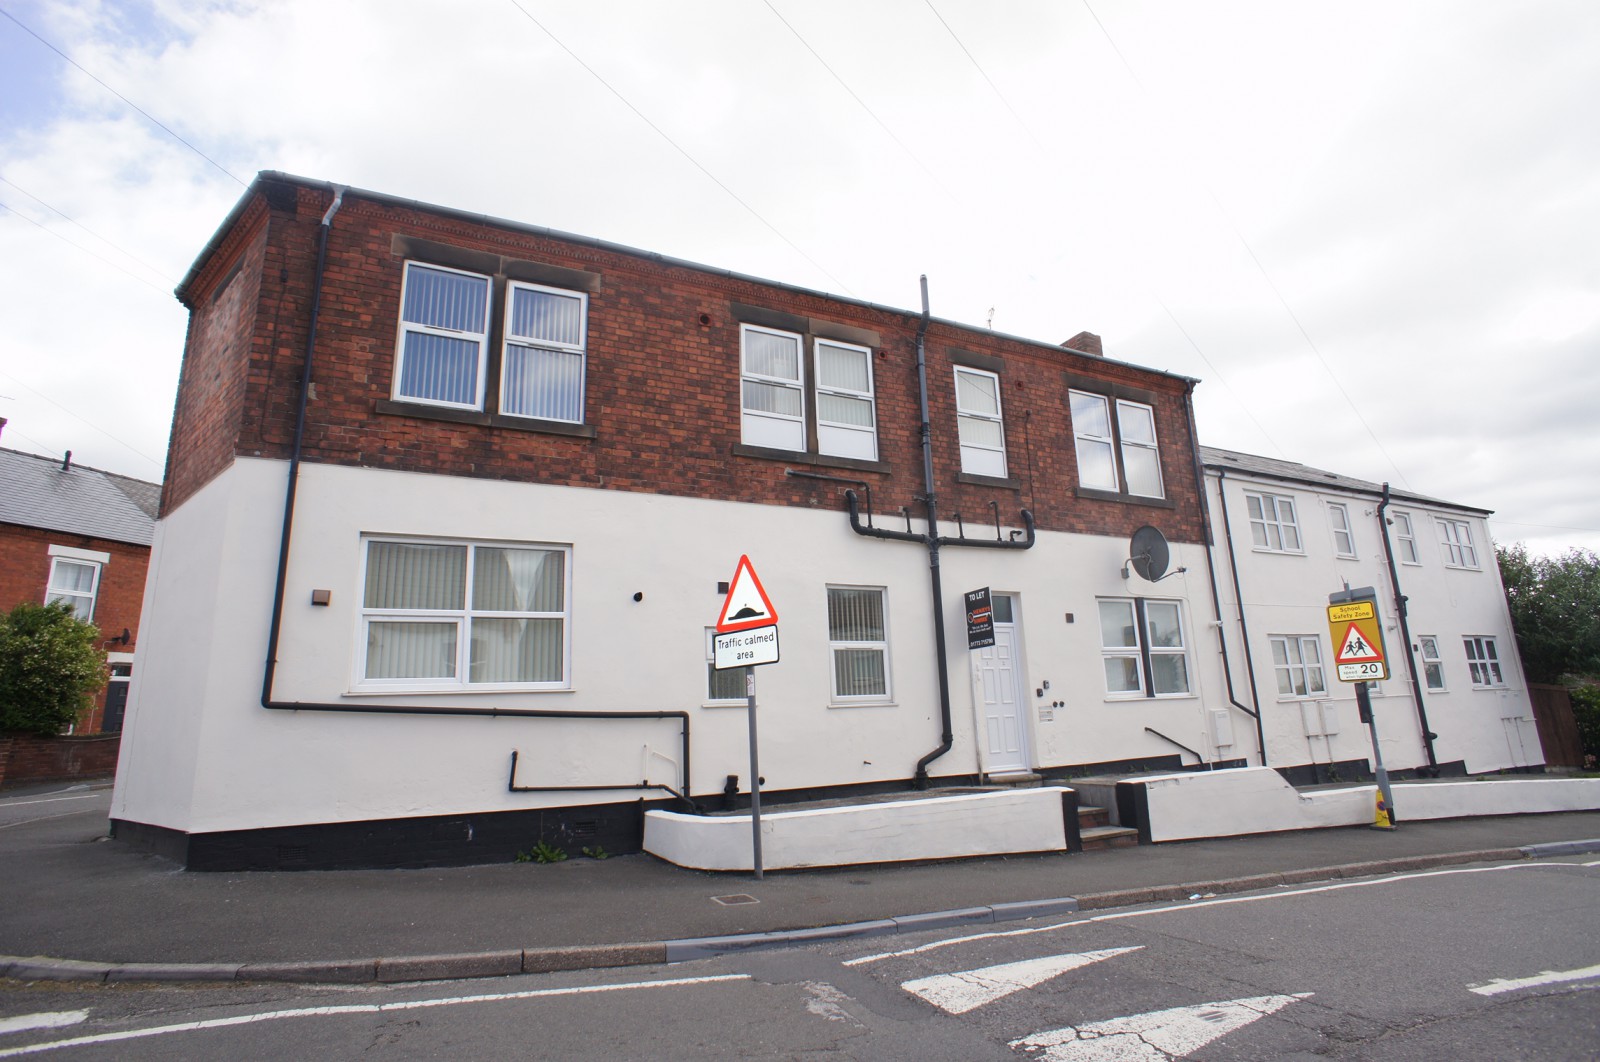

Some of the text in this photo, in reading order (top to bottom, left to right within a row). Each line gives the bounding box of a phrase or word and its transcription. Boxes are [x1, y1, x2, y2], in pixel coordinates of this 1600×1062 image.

[976, 591, 985, 600] LET
[718, 632, 774, 650] Traffic calmed
[736, 650, 754, 660] area
[1360, 664, 1378, 674] 20
